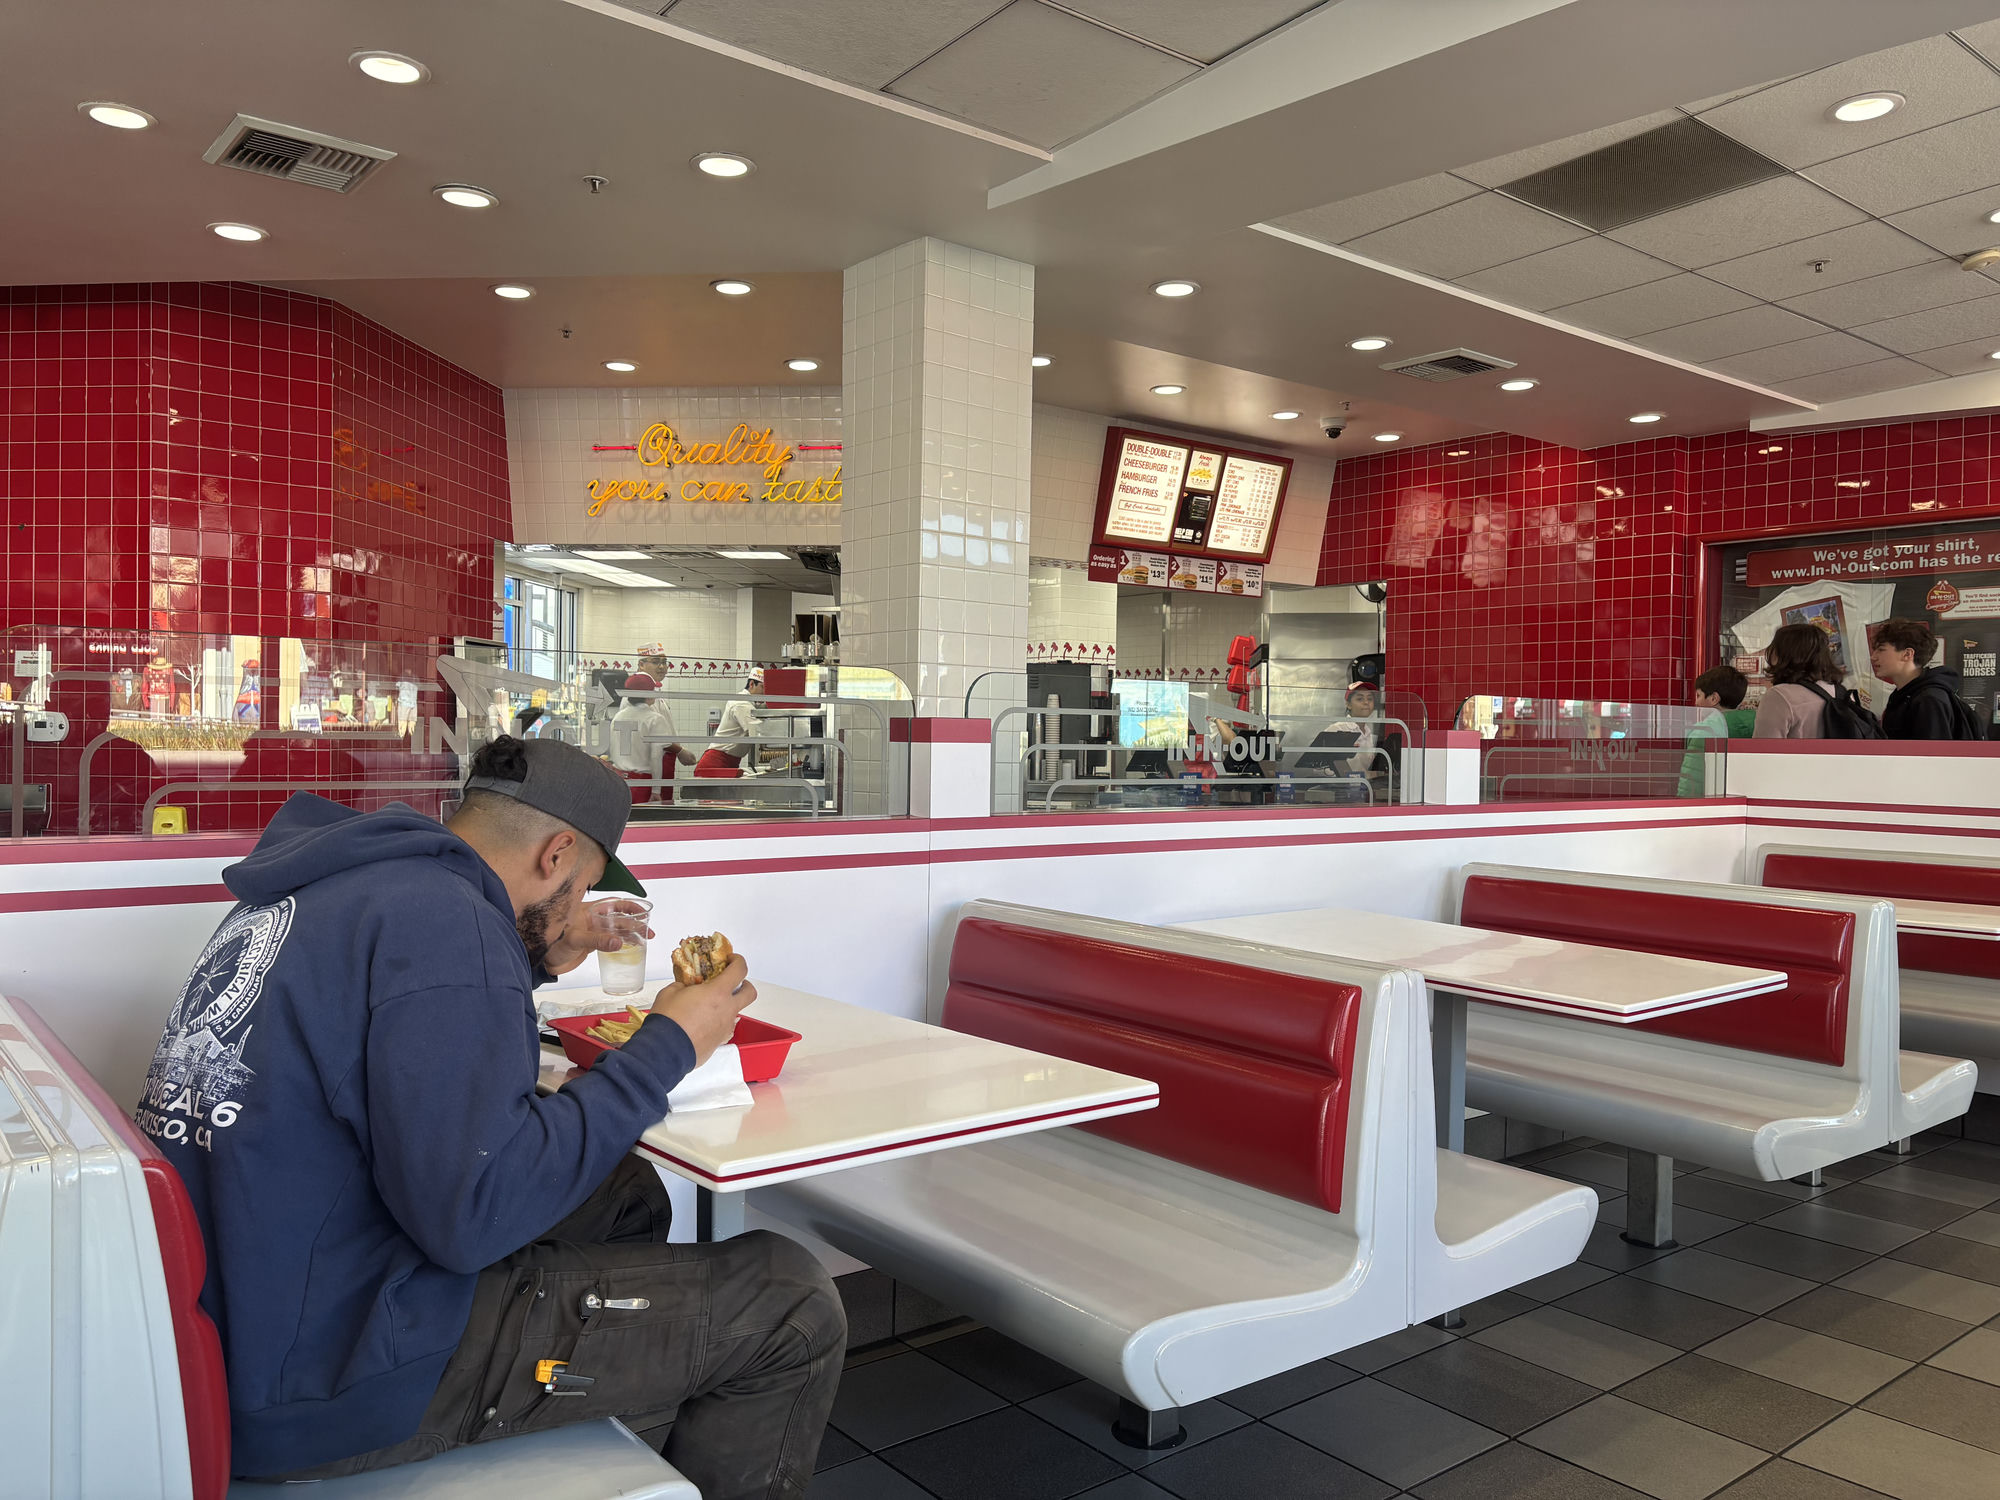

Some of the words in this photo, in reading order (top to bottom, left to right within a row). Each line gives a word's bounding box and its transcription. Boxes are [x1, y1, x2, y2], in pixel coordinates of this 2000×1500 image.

[637, 423, 793, 479] Quality
[1126, 442, 1173, 458] DOUBLE-DOUBLE
[1123, 458, 1168, 472] CHEESEBURGER
[1121, 471, 1158, 484] HAMBURGER
[587, 479, 668, 517] you
[680, 479, 751, 502] can
[761, 466, 842, 503] tast
[1118, 484, 1141, 495] FRENCH
[1142, 488, 1158, 498] FRIES
[1813, 548, 1858, 562] We've
[1864, 545, 1889, 560] got
[1895, 543, 1930, 558] your
[1935, 538, 1980, 552] shirt,
[1093, 554, 1115, 563] Ordering
[1120, 555, 1126, 565] 1
[1171, 561, 1176, 570] 2
[1771, 560, 1914, 579] www.In-N-Out.com
[1920, 556, 1948, 568] has
[1954, 553, 1981, 565] the
[1219, 567, 1224, 576] 3
[1963, 659, 1996, 668] TROJAN
[1963, 668, 1996, 676] HORSES
[1167, 735, 1279, 762] IN-N-OUT
[1570, 740, 1639, 760] IN-N-OUT
[231, 976, 260, 1019] CANADIAN
[211, 1101, 243, 1128] 6
[195, 1126, 212, 1152] CA
